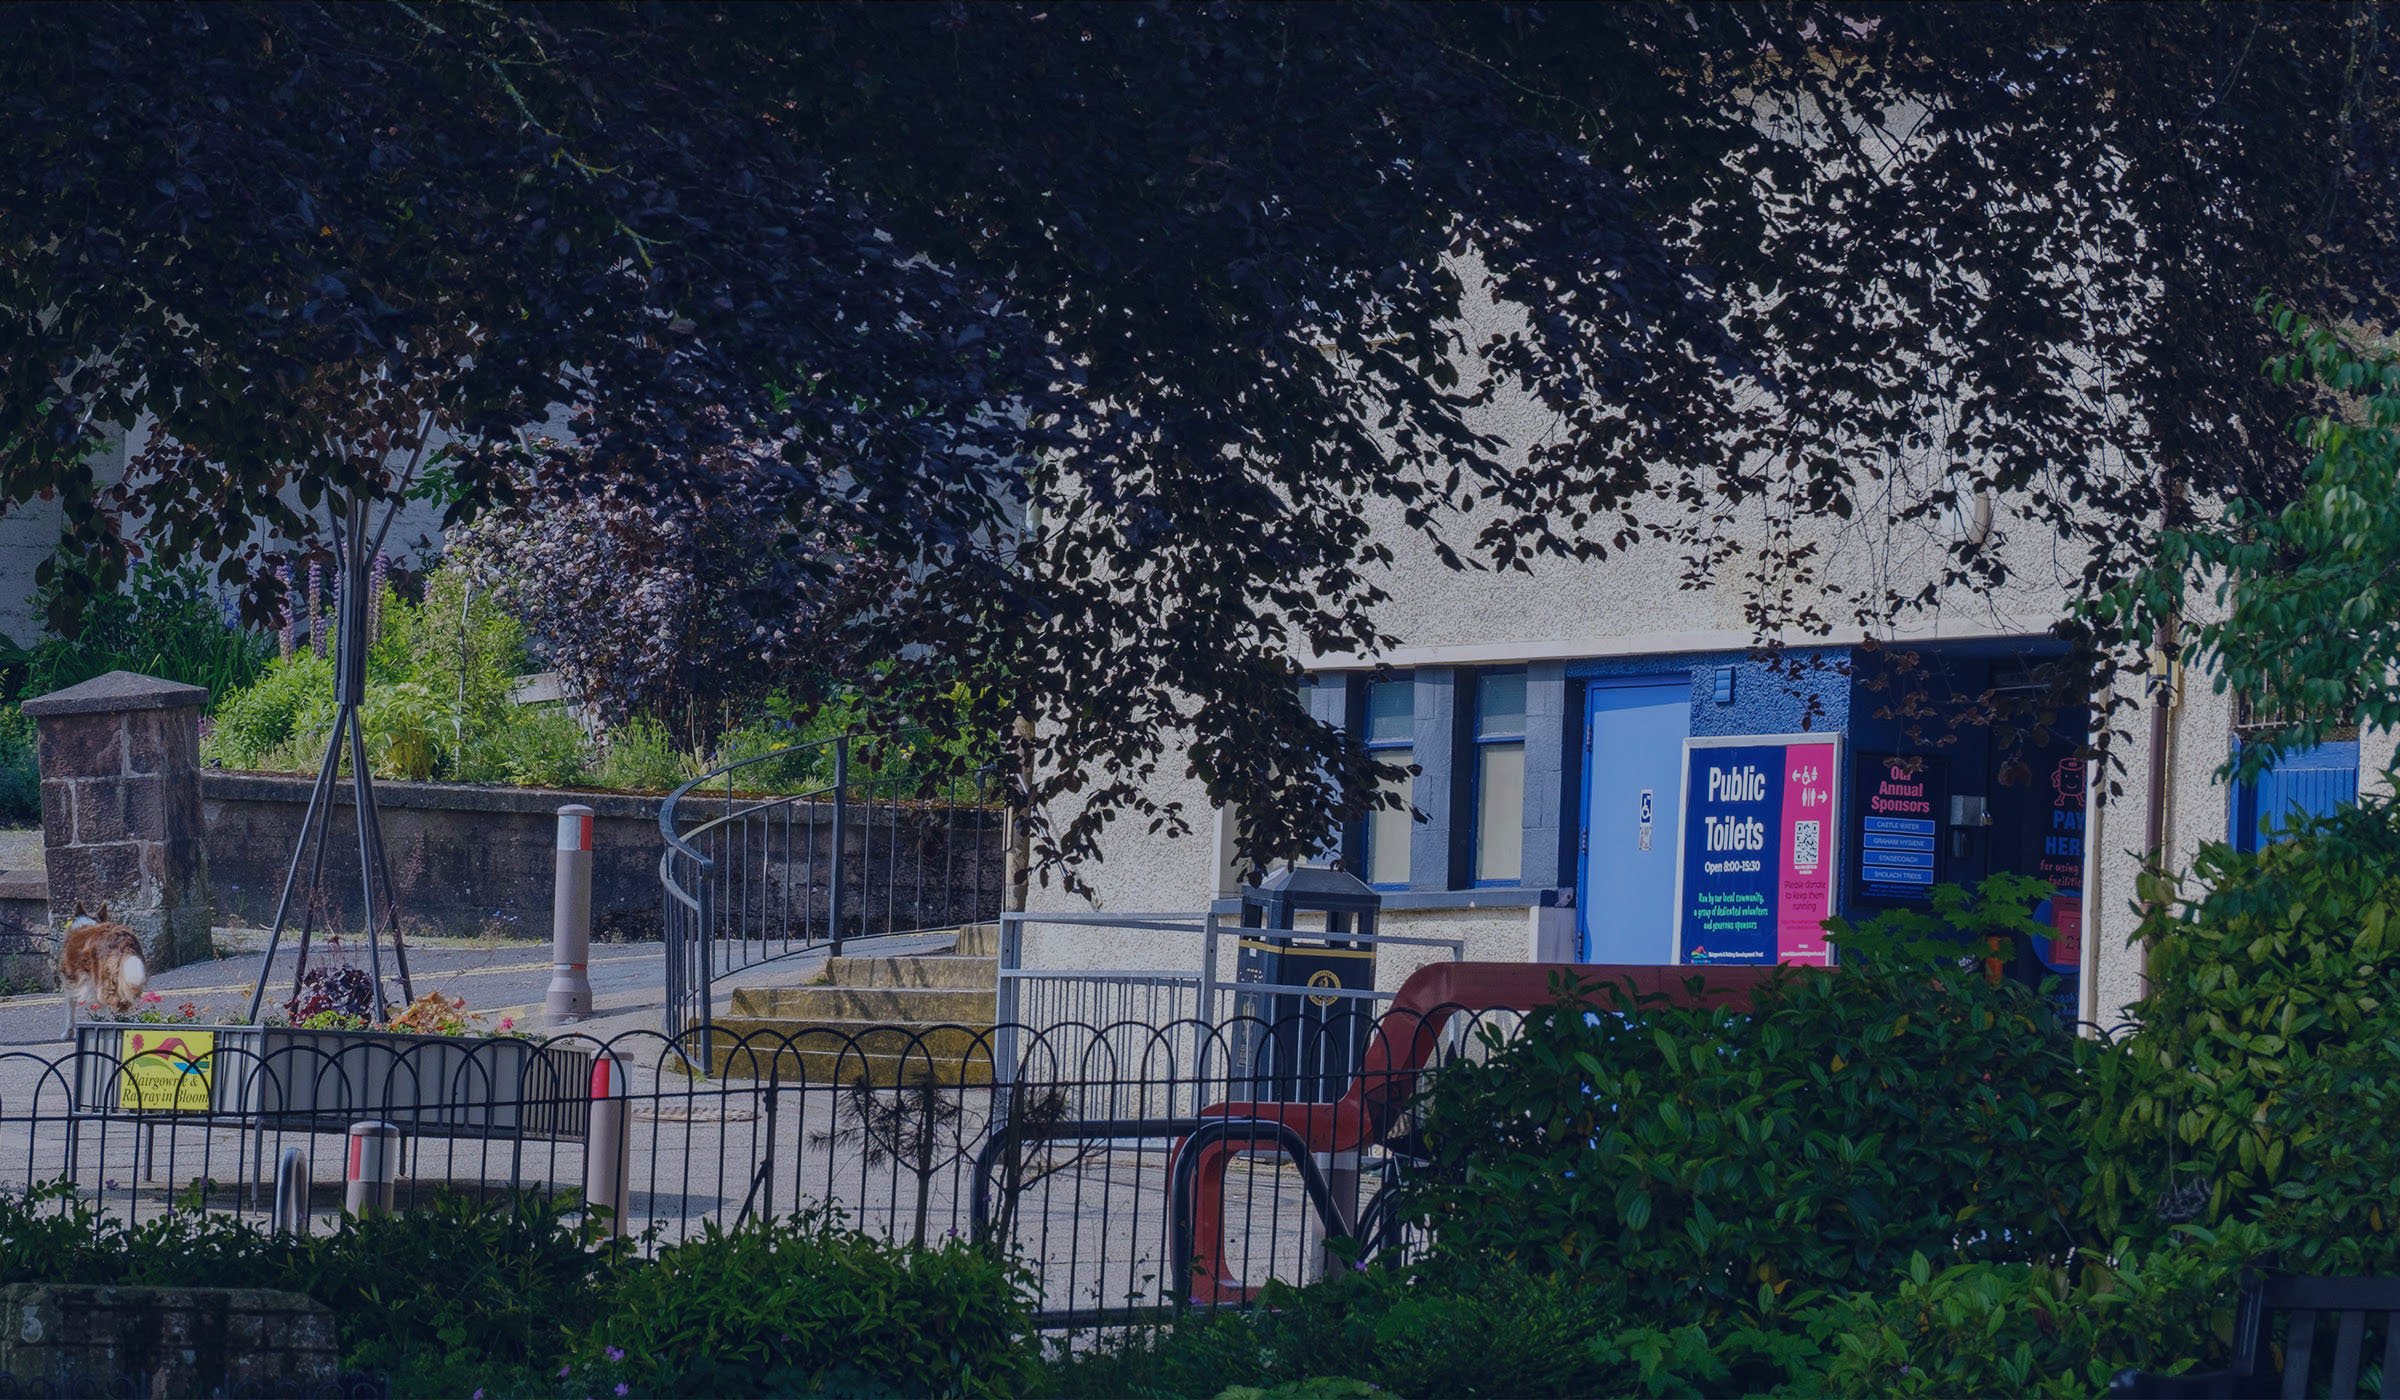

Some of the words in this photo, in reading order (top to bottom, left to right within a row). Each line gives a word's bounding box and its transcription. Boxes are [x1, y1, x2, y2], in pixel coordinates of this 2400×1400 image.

[1708, 765, 1765, 802] Public
[1879, 781, 1924, 797] Annual
[1871, 795, 1930, 813] Sponsors
[1876, 821, 1899, 829] CASTLE
[1900, 823, 1920, 831] WATER
[2053, 808, 2085, 830] PAY
[1704, 815, 1764, 851] Toilets
[1873, 837, 1898, 845] GRAHAM
[1899, 839, 1925, 847] HYGIENE
[2045, 835, 2082, 856] HER
[1878, 854, 1918, 863] STAGECOACH
[1704, 860, 1722, 875] Open
[1723, 860, 1760, 873] 8:00-15:30
[2040, 859, 2053, 872] for
[2055, 863, 2079, 876] using
[1784, 880, 1804, 889] Please
[1805, 879, 1826, 889] donate
[1698, 892, 1708, 903] Run
[1708, 891, 1714, 905] by
[1723, 891, 1735, 903] local
[1793, 891, 1808, 902] keep
[1809, 891, 1825, 899] them
[1698, 909, 1711, 919] group
[1712, 905, 1717, 916] of
[1717, 905, 1741, 916] dedicated
[1742, 905, 1768, 916] volunteers
[1792, 902, 1816, 912] running
[1703, 919, 1712, 930] and
[1712, 921, 1734, 932] generous
[1734, 921, 1757, 932] sponsors
[127, 1072, 188, 1090] Blairgowre
[190, 1075, 199, 1087] &
[162, 1088, 172, 1102] in
